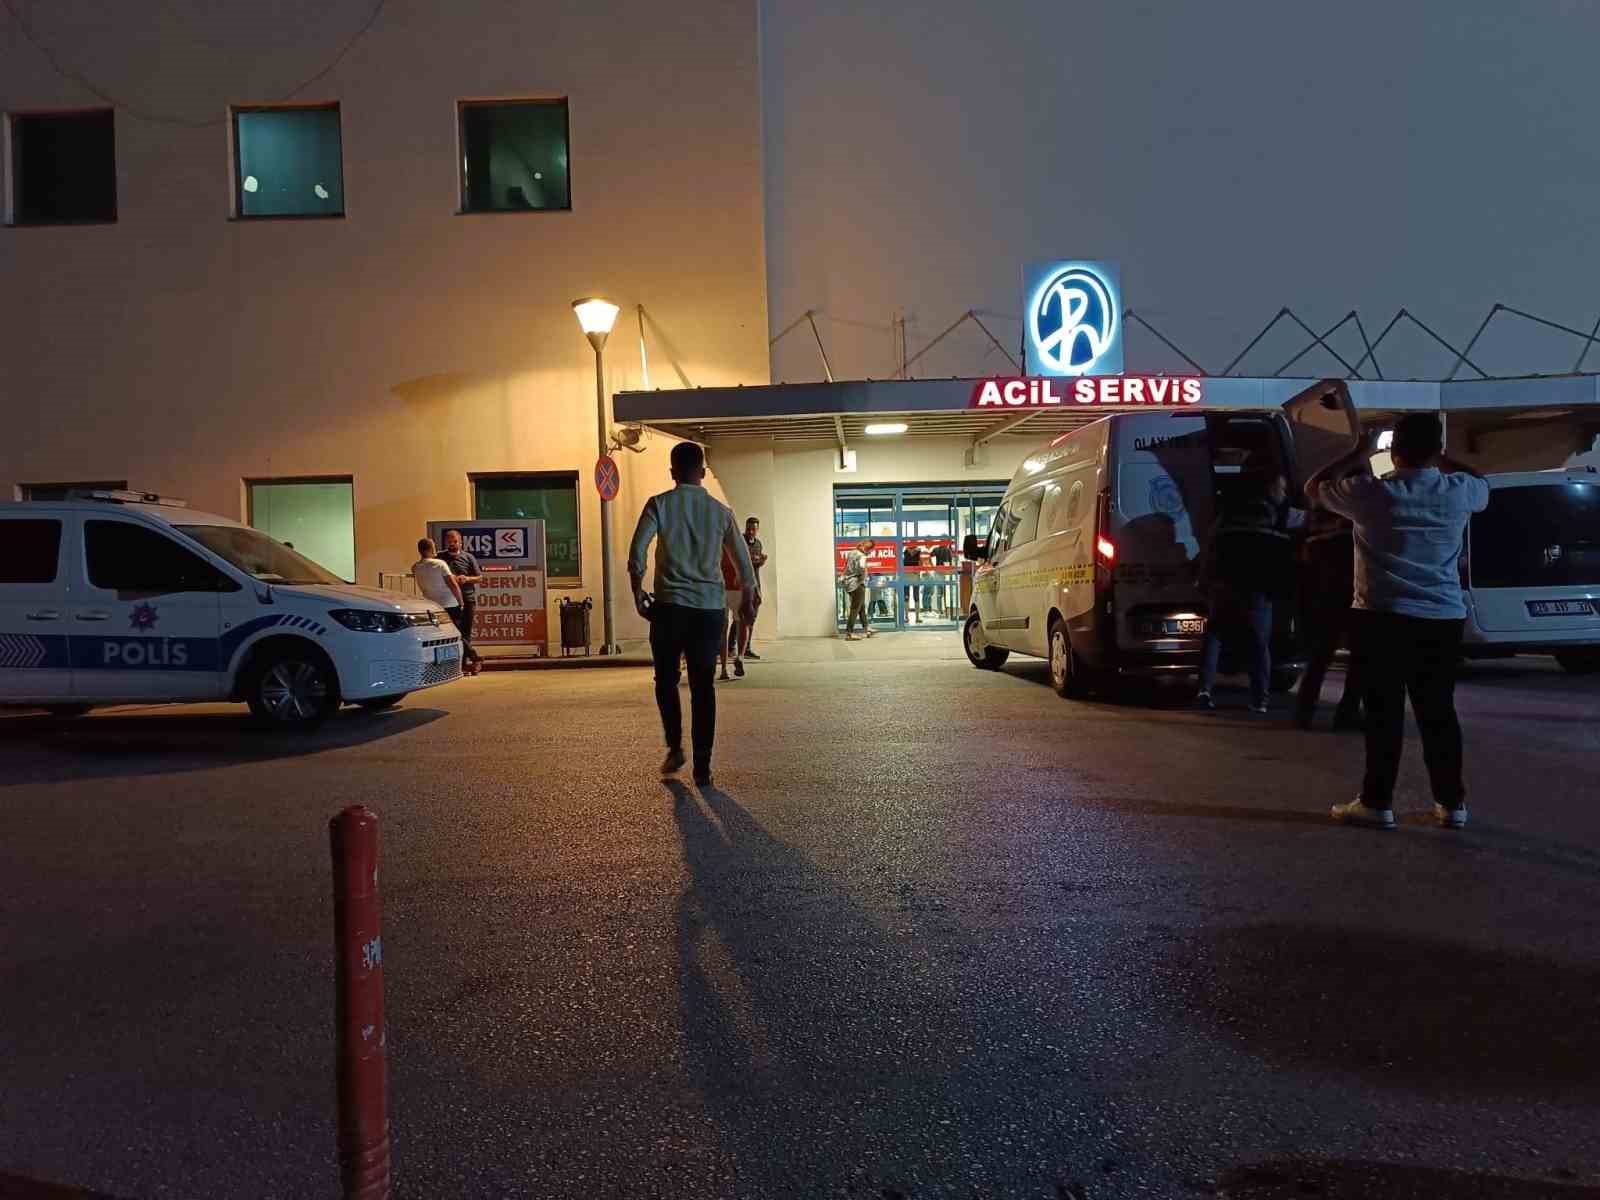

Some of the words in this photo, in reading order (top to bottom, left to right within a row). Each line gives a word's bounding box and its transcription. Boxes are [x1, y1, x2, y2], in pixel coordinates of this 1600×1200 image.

[464, 535, 492, 557] KIŞ
[477, 593, 523, 607] ÜDÜR
[484, 614, 534, 625] ETMEK
[471, 627, 524, 638] SAKTIR
[103, 637, 189, 665] POLİS
